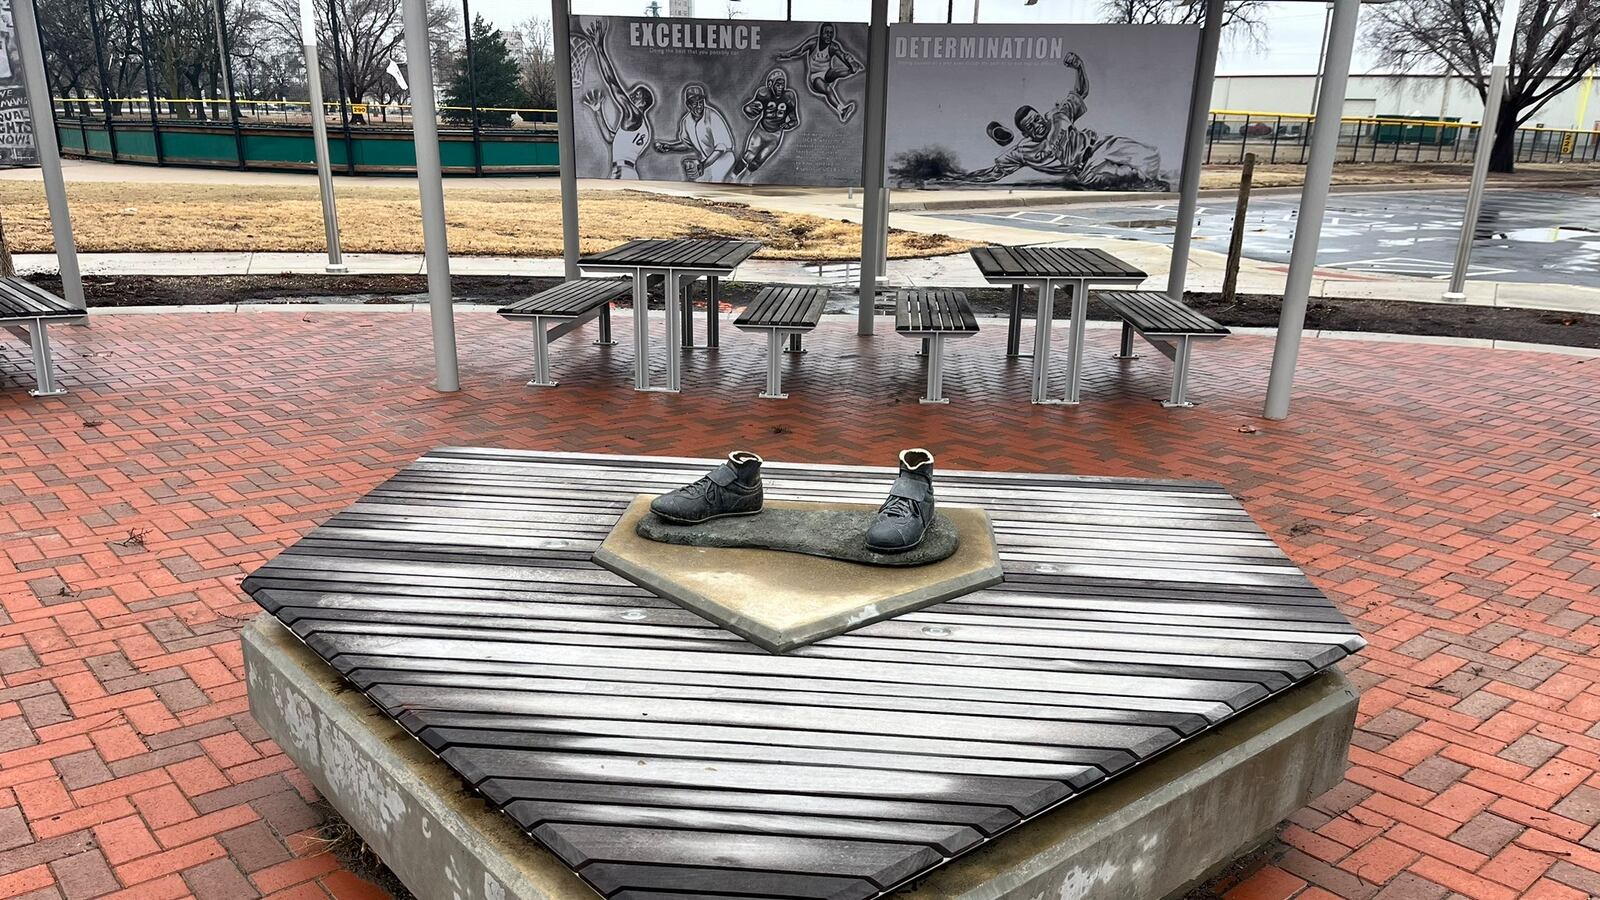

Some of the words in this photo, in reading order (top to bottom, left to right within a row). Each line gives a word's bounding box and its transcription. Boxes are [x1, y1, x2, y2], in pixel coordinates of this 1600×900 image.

[630, 22, 761, 49] EXCELLENCE
[895, 36, 1063, 58] DETERMINATION
[0, 110, 31, 122] QUAL
[632, 133, 646, 146] 18
[1562, 135, 1571, 153] 220
